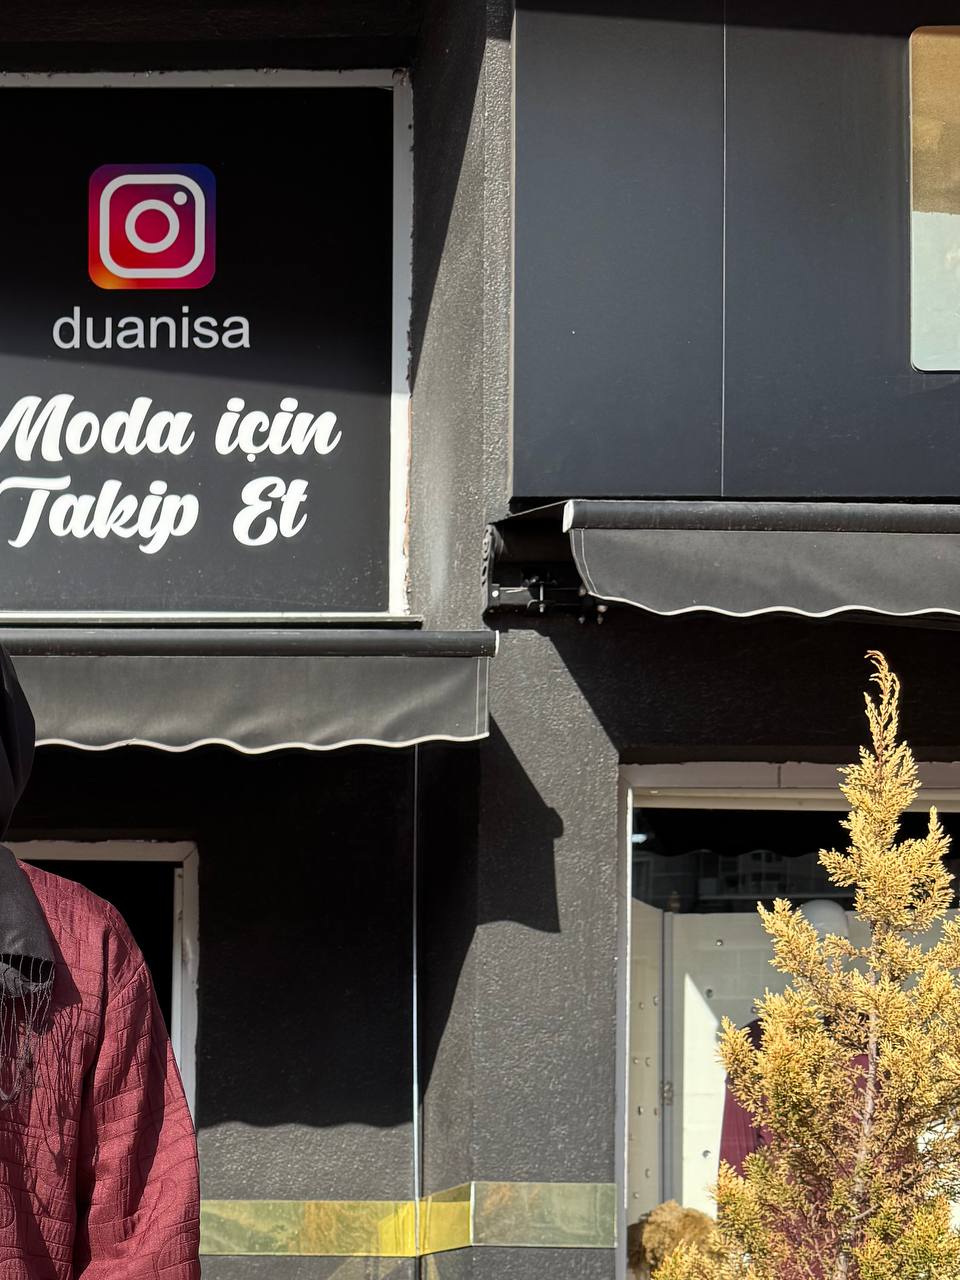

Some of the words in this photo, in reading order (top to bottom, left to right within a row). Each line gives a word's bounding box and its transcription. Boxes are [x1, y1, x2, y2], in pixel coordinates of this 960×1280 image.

[52, 305, 251, 350] duanisa
[214, 397, 343, 463] için
[232, 475, 309, 547] Et
